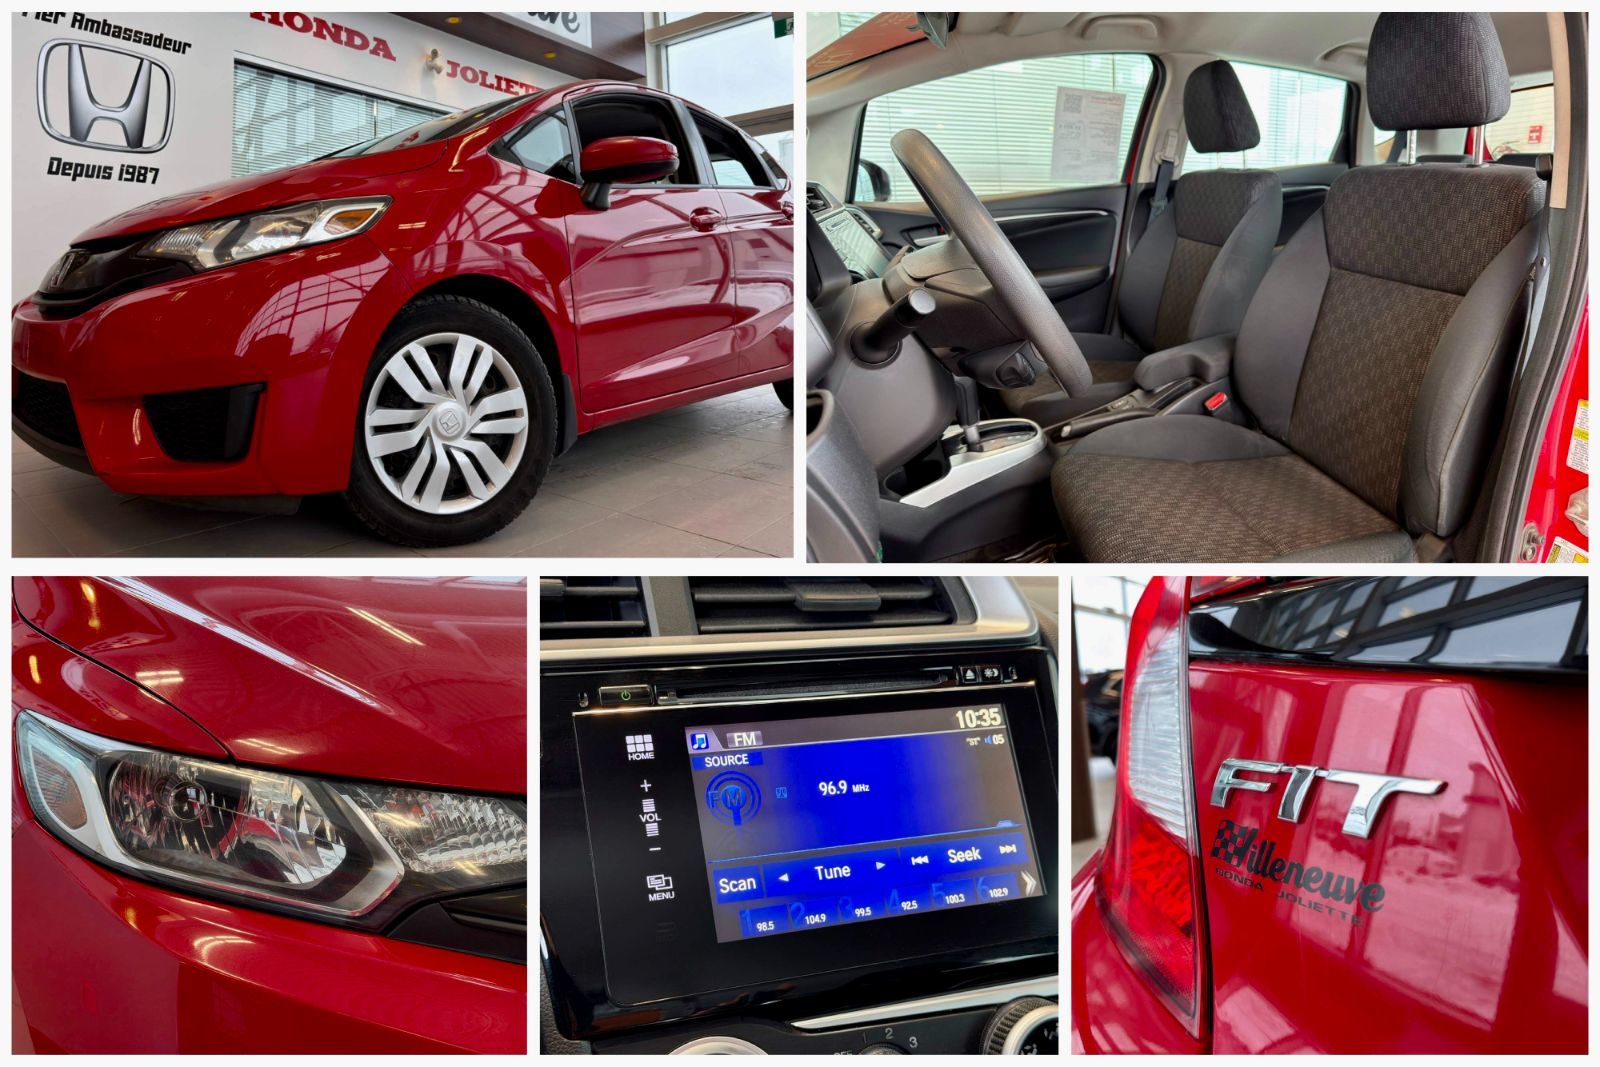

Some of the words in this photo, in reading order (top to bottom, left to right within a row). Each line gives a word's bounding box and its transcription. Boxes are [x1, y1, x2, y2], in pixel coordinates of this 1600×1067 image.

[70, 12, 192, 55] Ambassadeur
[446, 60, 545, 96] JOLIET
[47, 157, 113, 182] Depuis
[955, 707, 1002, 729] 10:35
[734, 732, 757, 747] FM
[992, 734, 1005, 745] 05
[628, 752, 655, 761] HOME
[704, 754, 750, 768] SOURCE
[818, 780, 848, 796] 96.9
[852, 784, 870, 793] MHz
[1210, 758, 1449, 839] FIT
[639, 814, 662, 823] VOL
[947, 846, 982, 864] Seek
[814, 864, 851, 881] Tune
[1211, 819, 1386, 913] Villeneuve
[719, 876, 757, 894] Scan
[648, 891, 675, 902] MENU
[945, 893, 966, 905] 100.3
[989, 887, 1009, 899] 102.9
[1215, 867, 1264, 892] HONDA
[1274, 890, 1365, 928] JOLIETTE
[854, 906, 872, 918] 99.5
[901, 900, 918, 911] 92.5
[756, 920, 775, 932] 98.5
[805, 913, 826, 925] 104.9
[884, 1027, 894, 1040] 2
[908, 1036, 919, 1049] 3
